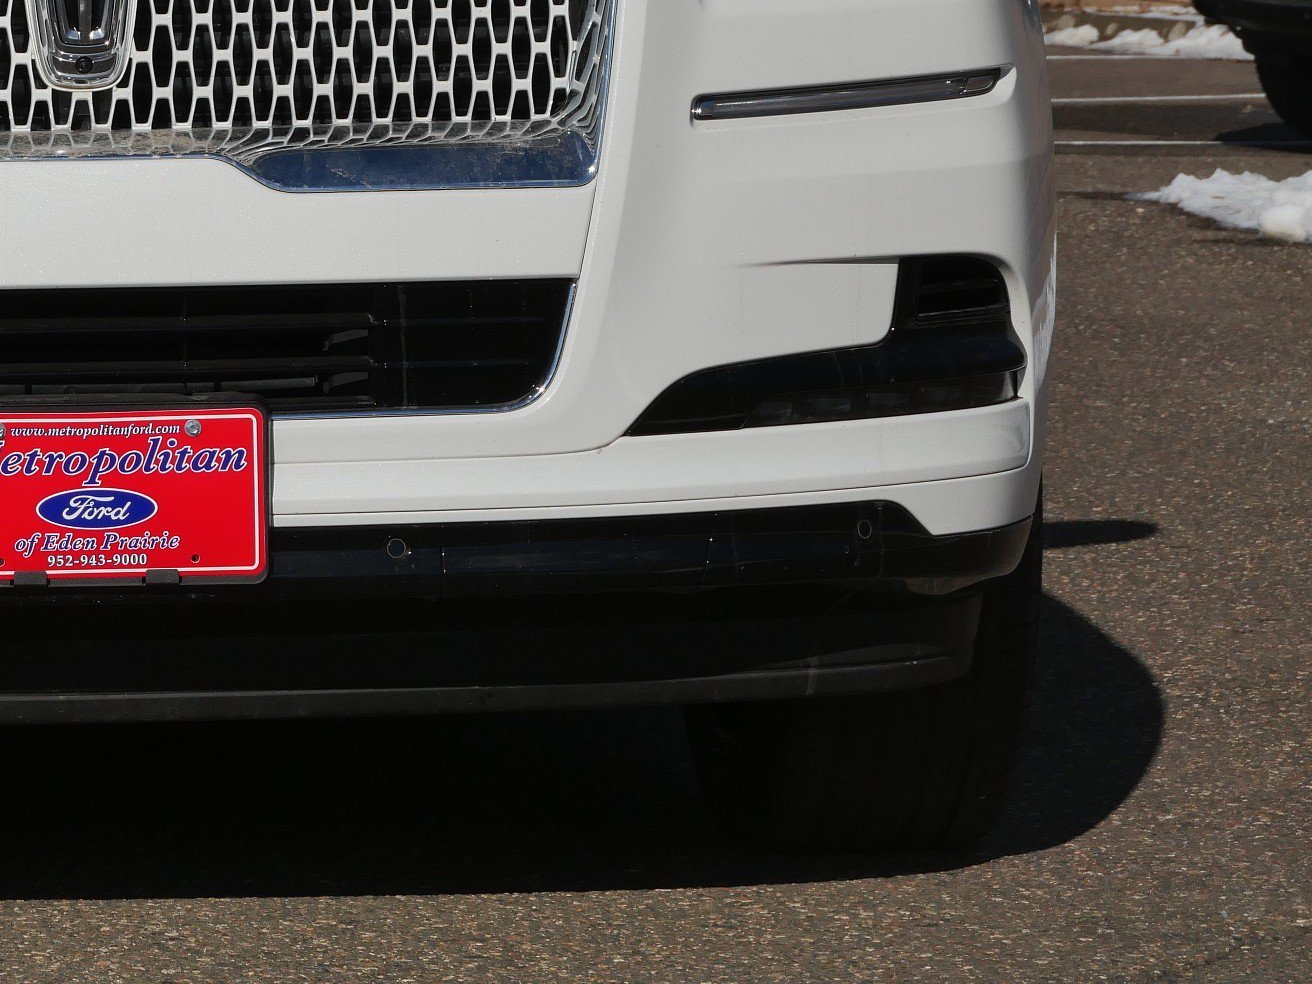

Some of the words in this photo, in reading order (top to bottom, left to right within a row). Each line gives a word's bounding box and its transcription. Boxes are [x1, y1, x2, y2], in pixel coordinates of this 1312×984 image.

[10, 423, 181, 440] www.metropolitanford.com
[62, 494, 130, 521] Ford
[14, 534, 40, 557] of
[42, 532, 97, 551] Eden
[101, 530, 180, 552] Prairie
[47, 553, 148, 567] 952-943-9000
